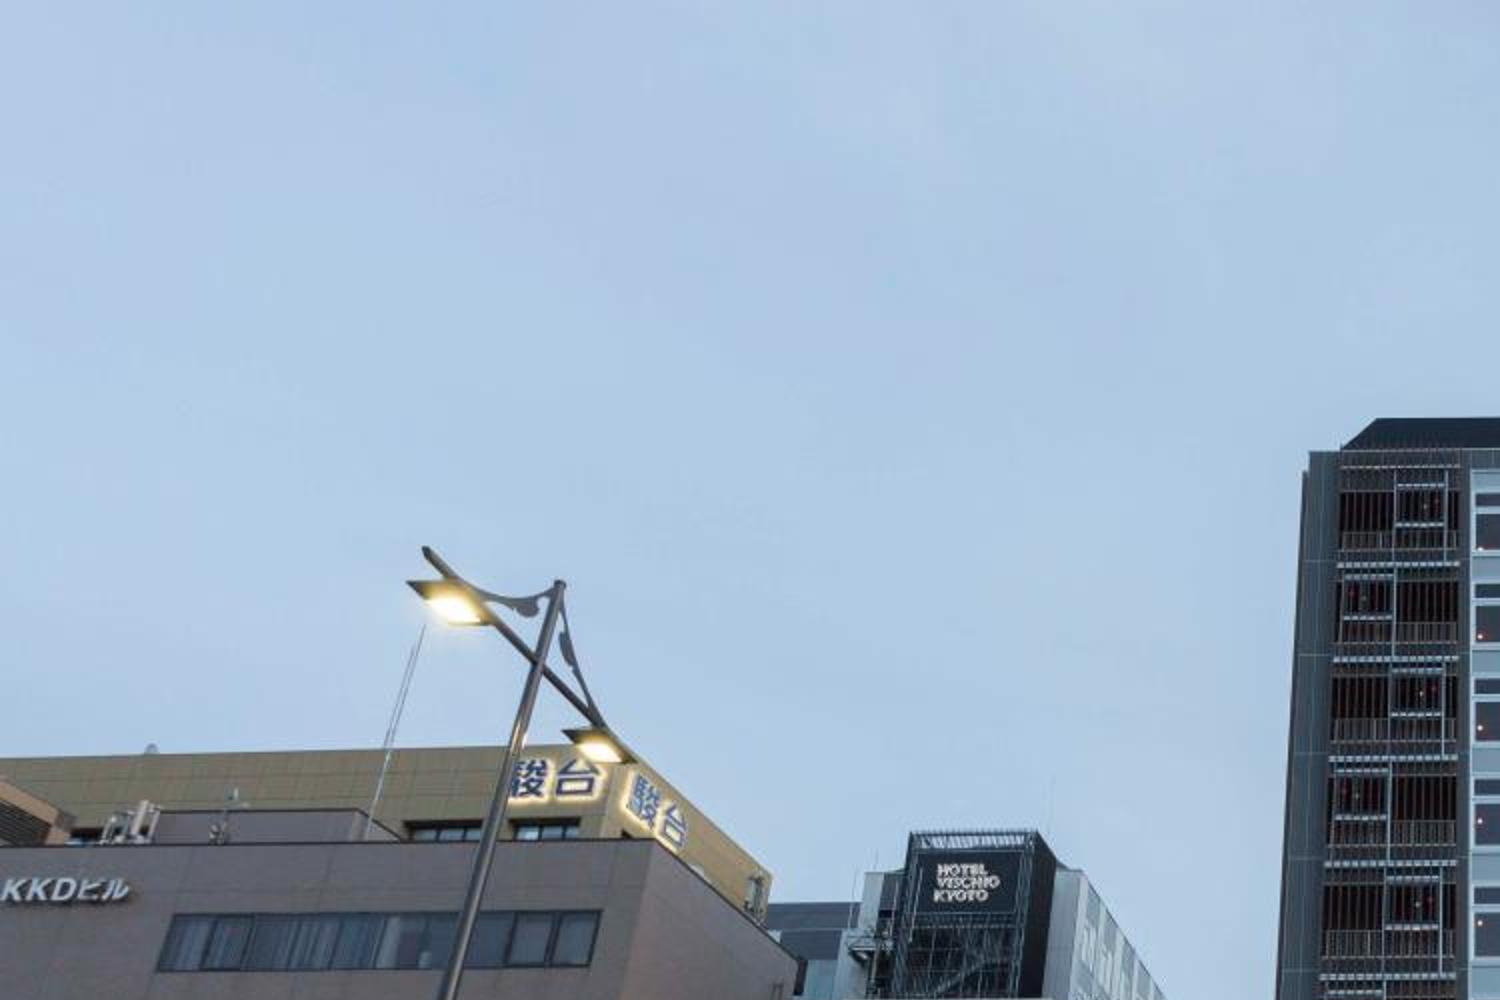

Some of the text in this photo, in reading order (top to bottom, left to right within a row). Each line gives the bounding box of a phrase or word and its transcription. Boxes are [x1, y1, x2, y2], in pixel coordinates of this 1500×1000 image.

[937, 863, 987, 877] HOTEL
[937, 875, 1001, 889] VISCHIO
[933, 889, 989, 903] KYOTO
